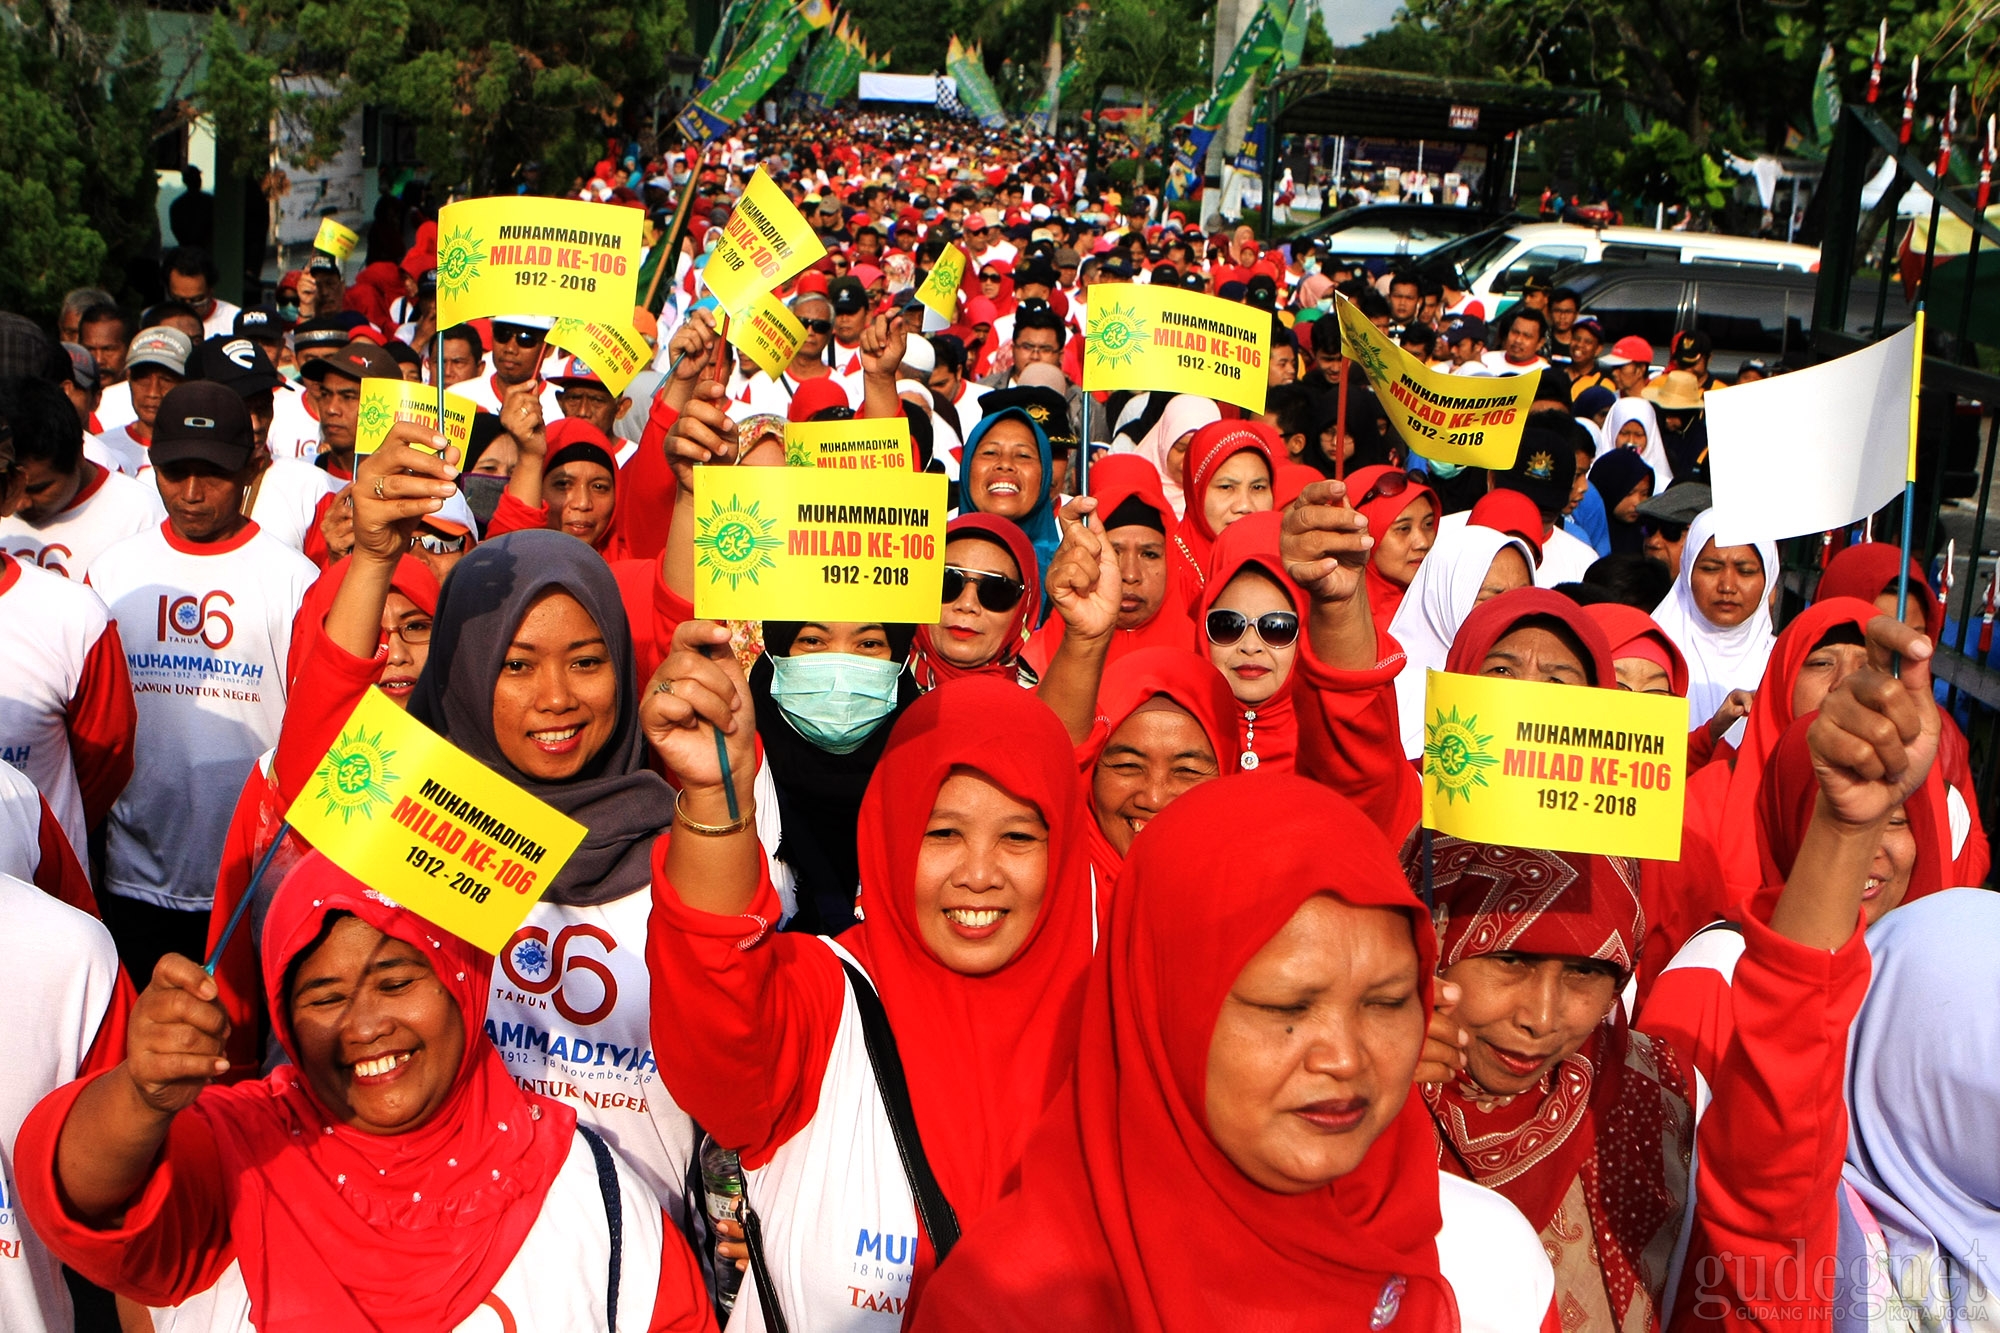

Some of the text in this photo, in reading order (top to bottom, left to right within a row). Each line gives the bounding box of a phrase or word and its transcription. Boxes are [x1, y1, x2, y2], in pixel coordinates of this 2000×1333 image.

[499, 225, 621, 249] MUHAMMADIYAH
[740, 196, 793, 260] MUHAMMADIYAH
[489, 245, 627, 276] MILAD KE-106
[723, 248, 745, 271] 2018
[735, 228, 780, 279] KE-106
[514, 271, 548, 287] 1912
[560, 274, 596, 292] 2018
[1161, 311, 1257, 344] MUHAMMADIYAH
[584, 322, 635, 376] MILAD KE-106
[589, 341, 605, 357] 1912
[604, 356, 620, 374] 2018
[1153, 328, 1262, 368] MILAD KE-106
[1177, 354, 1204, 371] 1912
[1214, 361, 1241, 380] 2018
[1389, 380, 1518, 429] MILAD KE-106
[1400, 373, 1518, 410] MUHAMMADIYAH
[400, 399, 465, 424] MUHAMMDIYAH
[820, 438, 900, 453] MUHAMMADIYAH
[1407, 415, 1438, 440] 1912
[1447, 431, 1484, 446] 2018
[816, 452, 906, 470] MILAD KE-106
[797, 503, 930, 528] MUHAMMADIYAH
[787, 529, 936, 561] MILAD KE-106
[821, 564, 860, 585] 1912
[872, 566, 910, 586] 2018
[157, 589, 235, 650] 106
[169, 636, 199, 645] TAHUN
[127, 653, 264, 679] MUHAMMADIYAH
[175, 683, 221, 699] UNTUK
[1516, 721, 1665, 755] MUHAMMADIYAH
[1502, 748, 1584, 783] MILAD
[1589, 755, 1673, 792] KE-106
[1537, 789, 1580, 811] 1912
[1593, 793, 1637, 817] 2018
[418, 778, 548, 865] MUHAMMADIYAH
[389, 795, 538, 896] MILAD KE-106
[405, 845, 446, 879] 1912
[448, 871, 492, 905] 2018
[496, 988, 547, 1011] TAHUN
[500, 1050, 528, 1064] 1912
[542, 1055, 556, 1068] 18
[560, 1064, 629, 1082] November
[853, 1262, 868, 1277] 18
